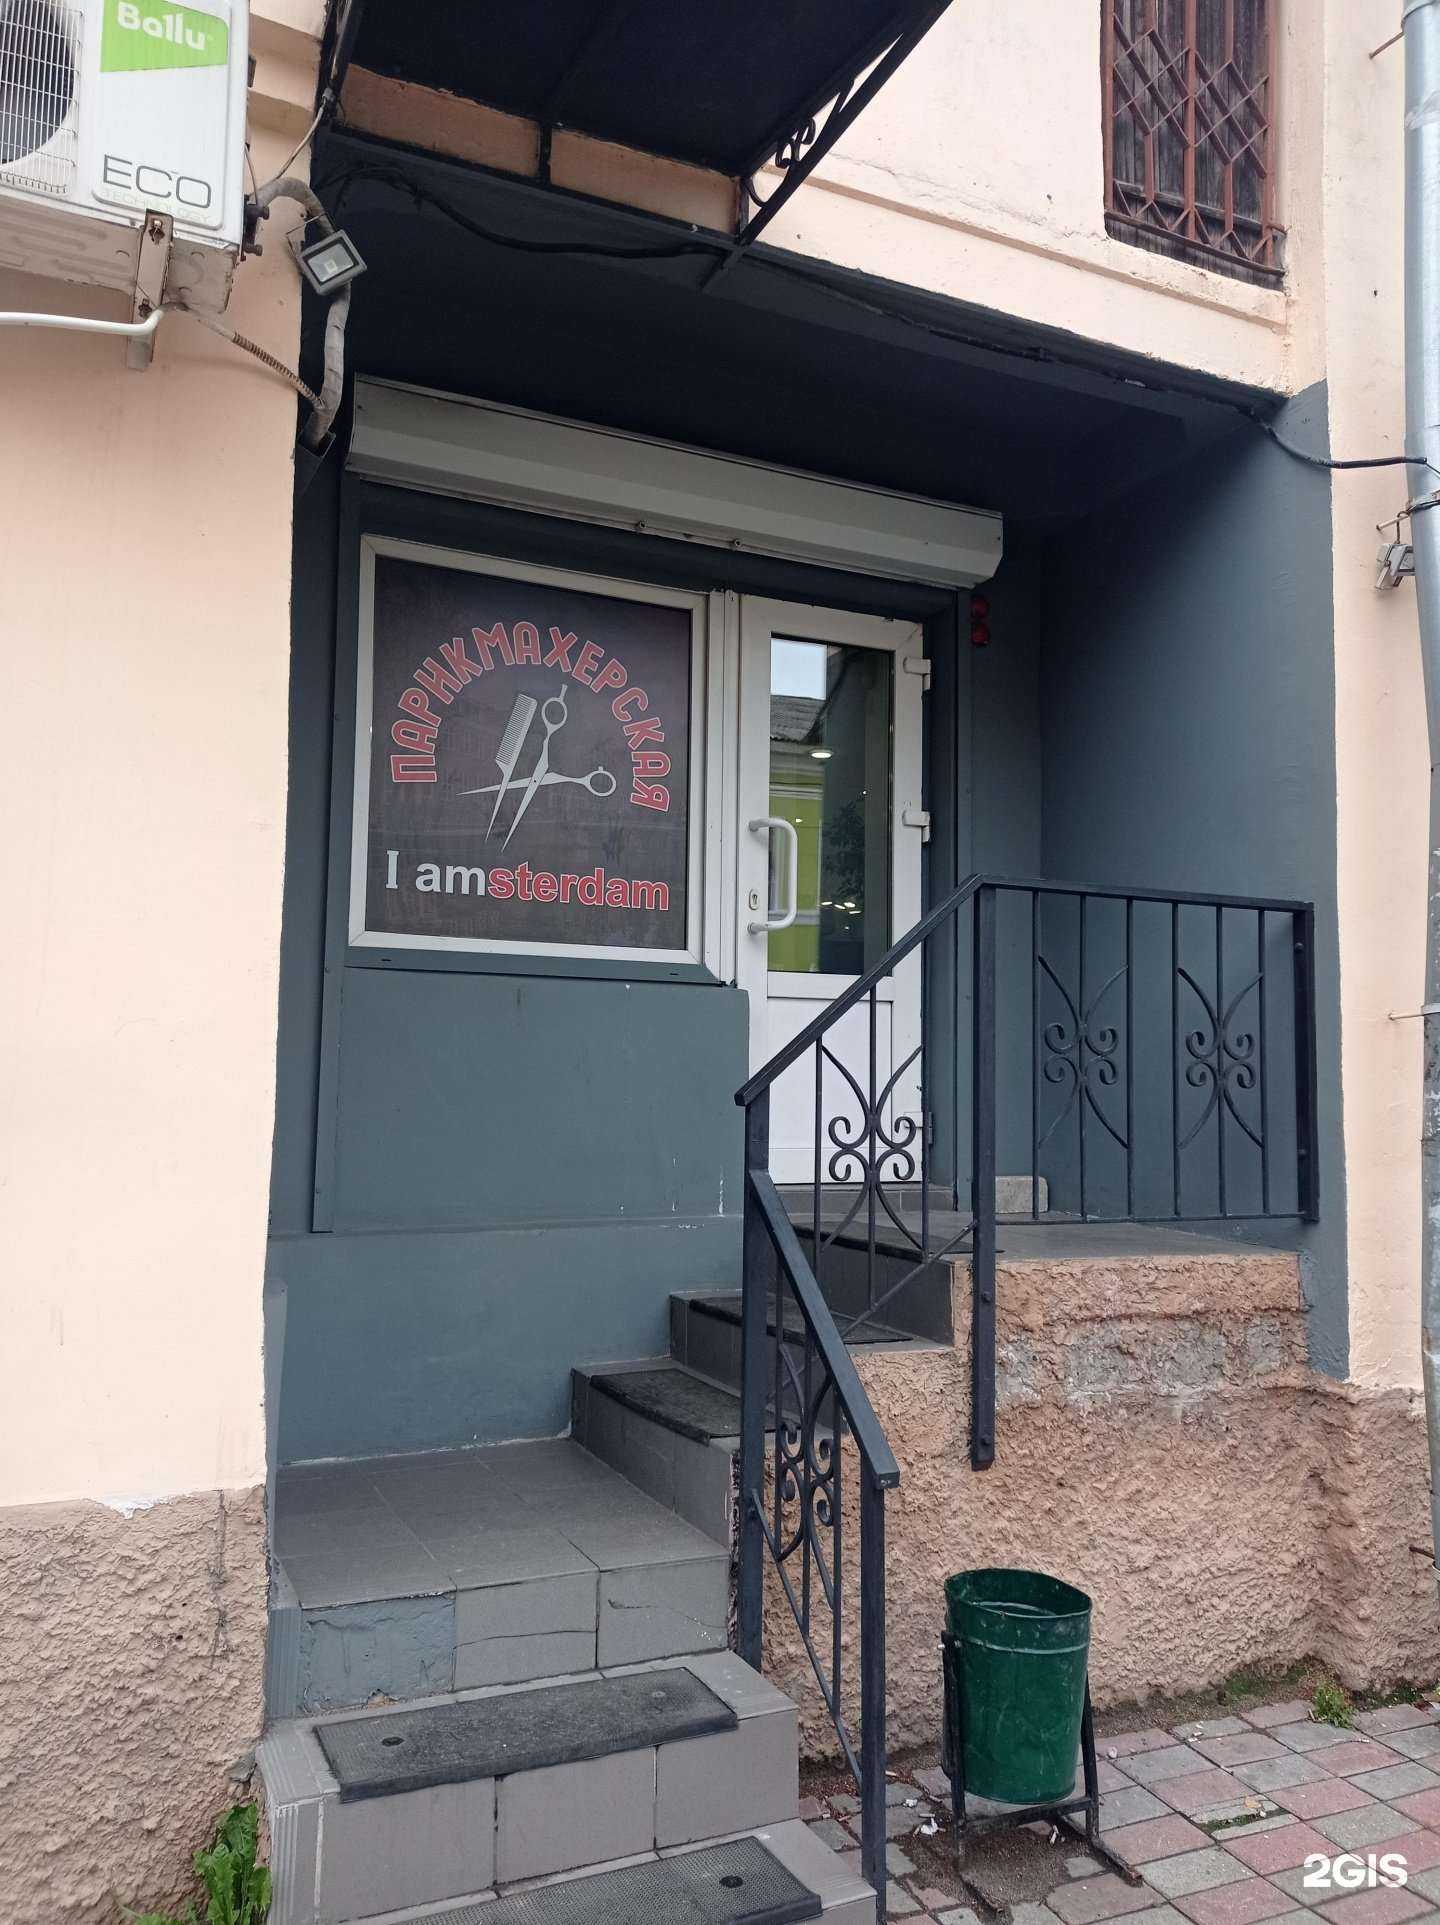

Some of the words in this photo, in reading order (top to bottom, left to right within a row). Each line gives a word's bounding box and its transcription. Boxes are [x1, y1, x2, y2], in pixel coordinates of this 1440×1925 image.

[117, 1, 207, 51] Ballu
[103, 154, 211, 209] ECO
[390, 621, 672, 812] ПАРИКМАХЕРСКАЯ
[386, 850, 400, 889] I
[415, 860, 670, 911] amsterdam
